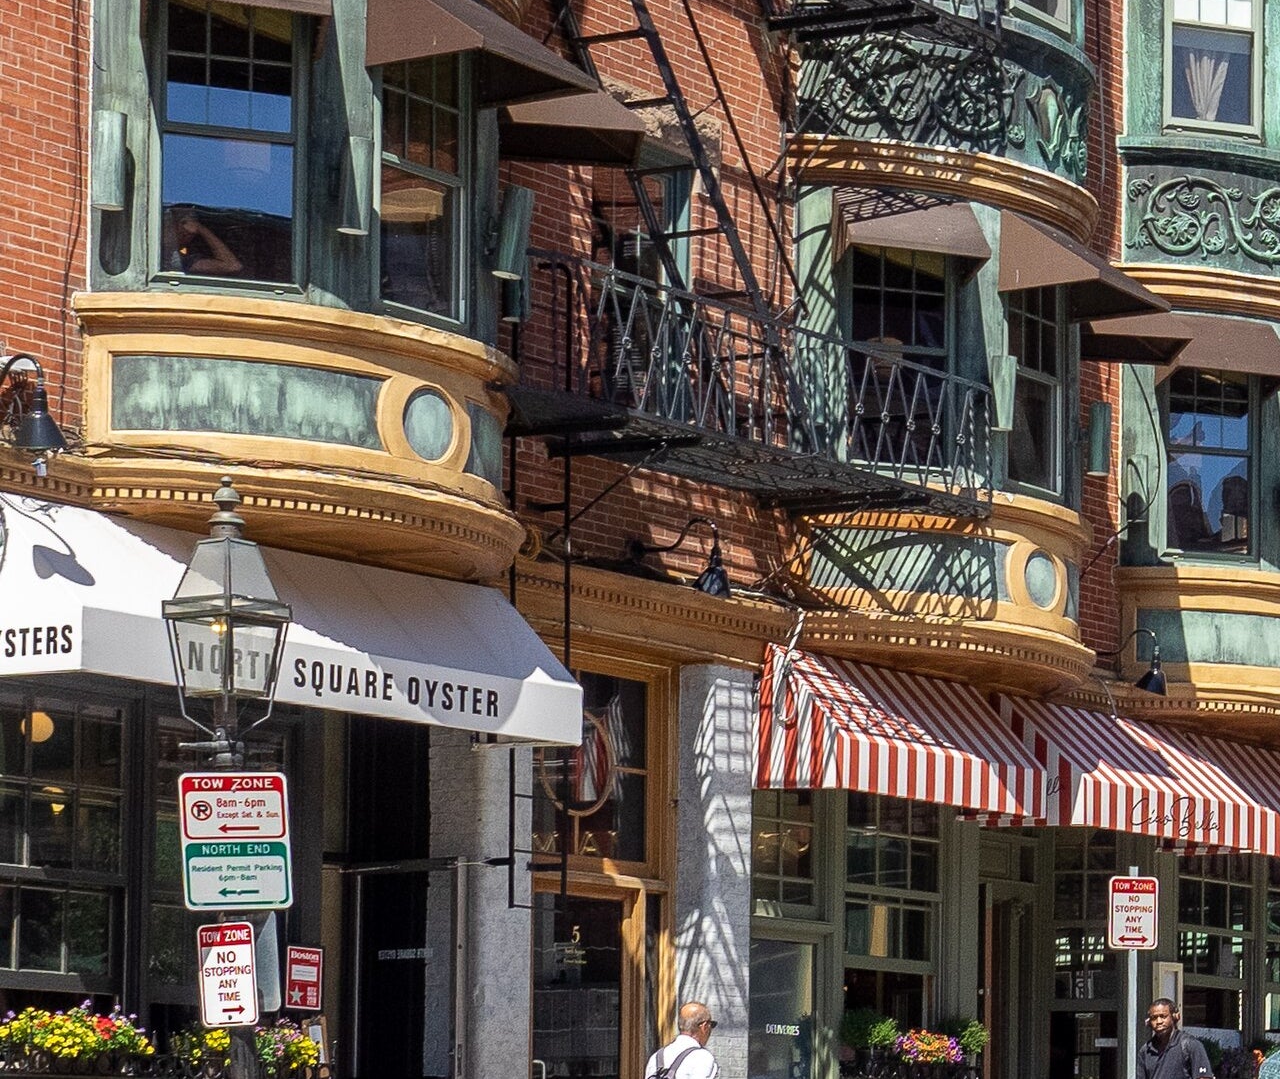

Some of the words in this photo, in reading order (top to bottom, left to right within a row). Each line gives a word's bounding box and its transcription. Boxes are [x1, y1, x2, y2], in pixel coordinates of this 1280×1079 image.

[0, 624, 73, 658] STERS
[293, 658, 394, 702] SQUARE
[407, 676, 499, 718] OYSTER
[192, 778, 224, 789] TOW
[231, 778, 274, 789] ZONE
[216, 811, 239, 819] Except
[202, 845, 241, 855] NORTH
[247, 844, 270, 854] END
[227, 864, 251, 872] Permit
[254, 864, 283, 872] Parking
[1114, 882, 1131, 890] TOW
[1133, 882, 1155, 891] ZONE
[1128, 895, 1140, 903] NO
[1115, 905, 1153, 913] STOPPING
[1125, 915, 1143, 923] ANY
[570, 925, 581, 944] 5
[1125, 925, 1143, 934] TIME
[201, 932, 221, 943] TOW
[224, 929, 250, 942] ZONE
[216, 950, 236, 964] NO
[290, 950, 319, 961] Boston
[204, 965, 252, 978] STOPPING
[218, 979, 238, 989] ANY
[217, 992, 241, 1002] TIME
[765, 1023, 800, 1036] DELIVERIES
